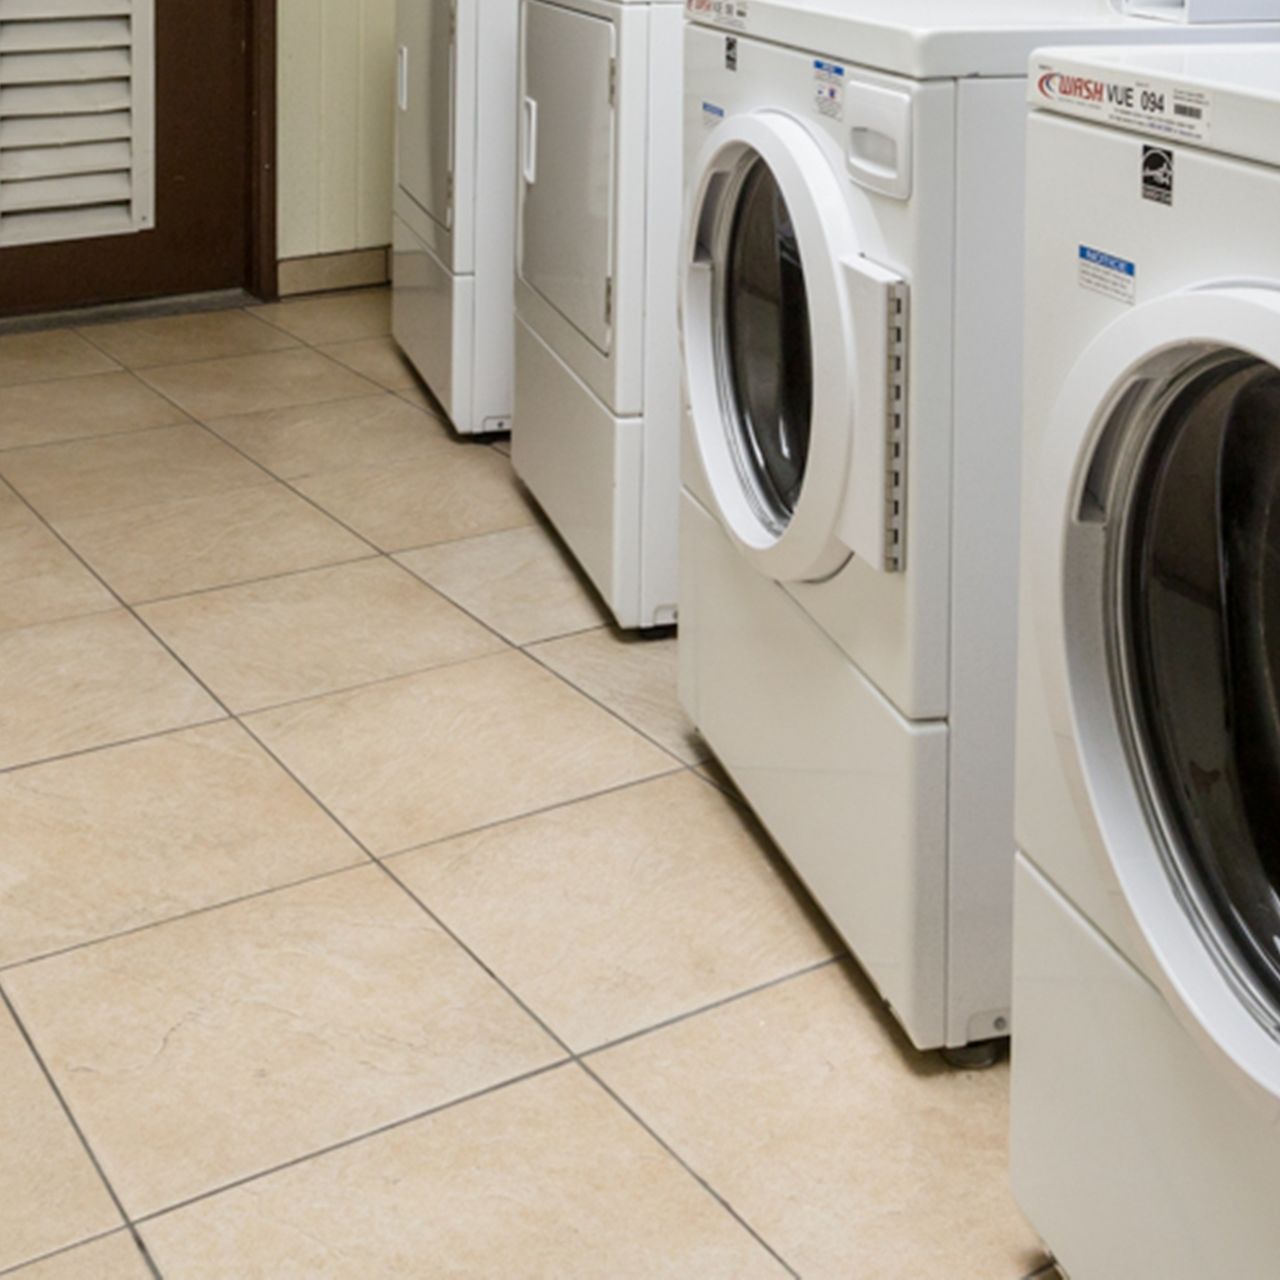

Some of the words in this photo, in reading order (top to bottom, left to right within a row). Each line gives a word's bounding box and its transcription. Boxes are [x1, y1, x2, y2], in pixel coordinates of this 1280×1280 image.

[1058, 74, 1104, 103] WASH
[1107, 83, 1134, 108] VUE
[1140, 90, 1165, 113] 094
